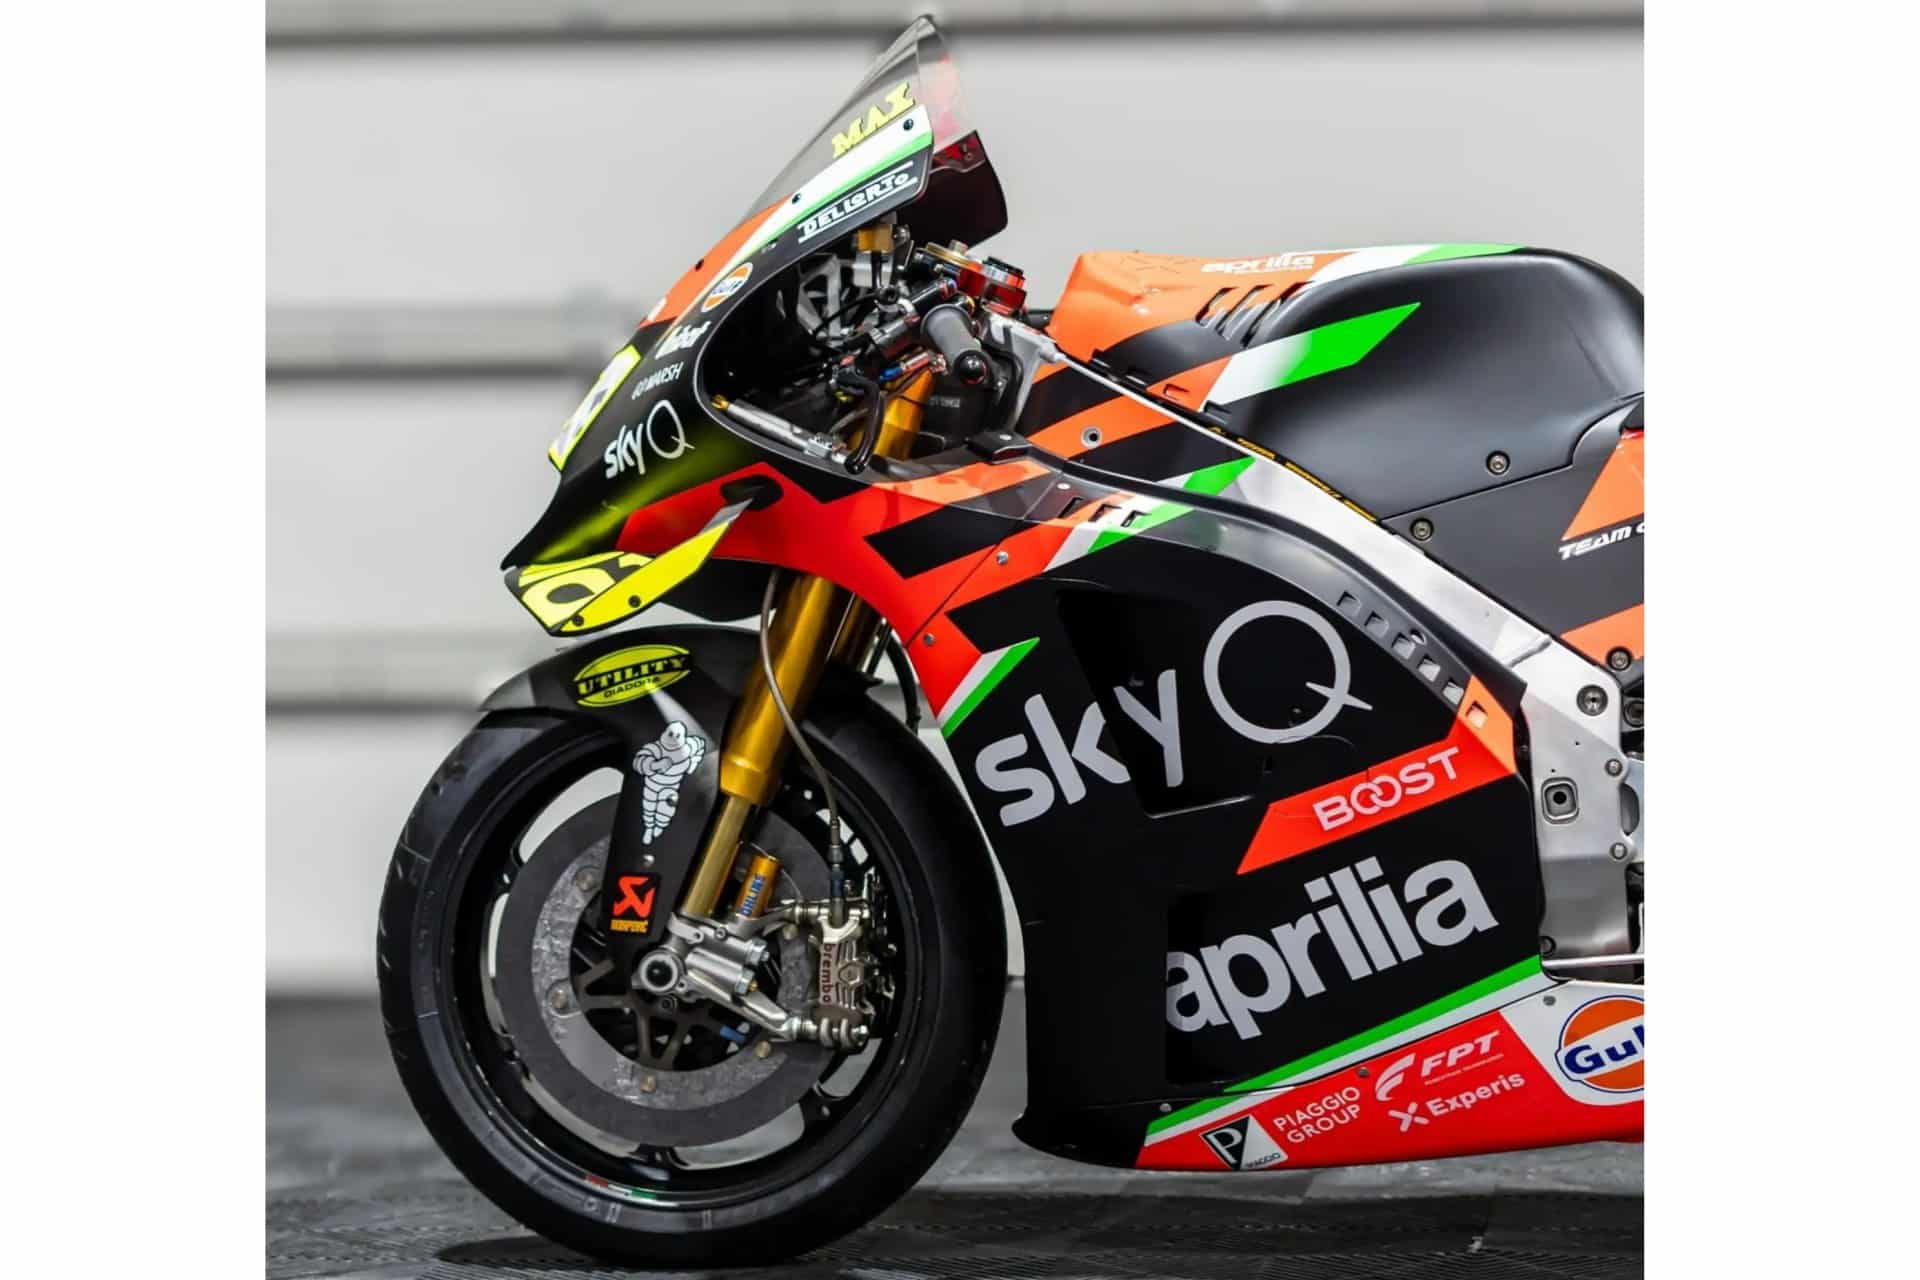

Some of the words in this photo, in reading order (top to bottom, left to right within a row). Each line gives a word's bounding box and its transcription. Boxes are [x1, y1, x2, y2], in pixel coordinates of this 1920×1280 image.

[604, 423, 646, 480] sky
[646, 399, 695, 460] Q
[1558, 526, 1632, 560] TEAM
[577, 656, 686, 695] UTILITY
[975, 668, 1184, 827] sky
[1203, 600, 1374, 744] Q
[1312, 747, 1460, 831] BOOST
[1165, 856, 1500, 1040] aprilia
[822, 944, 834, 1004] brembo
[1421, 1030, 1500, 1077] FPT
[1273, 1086, 1361, 1131] PIAGGIO
[1426, 1073, 1526, 1117] Experis
[1286, 1104, 1361, 1143] GROUP
